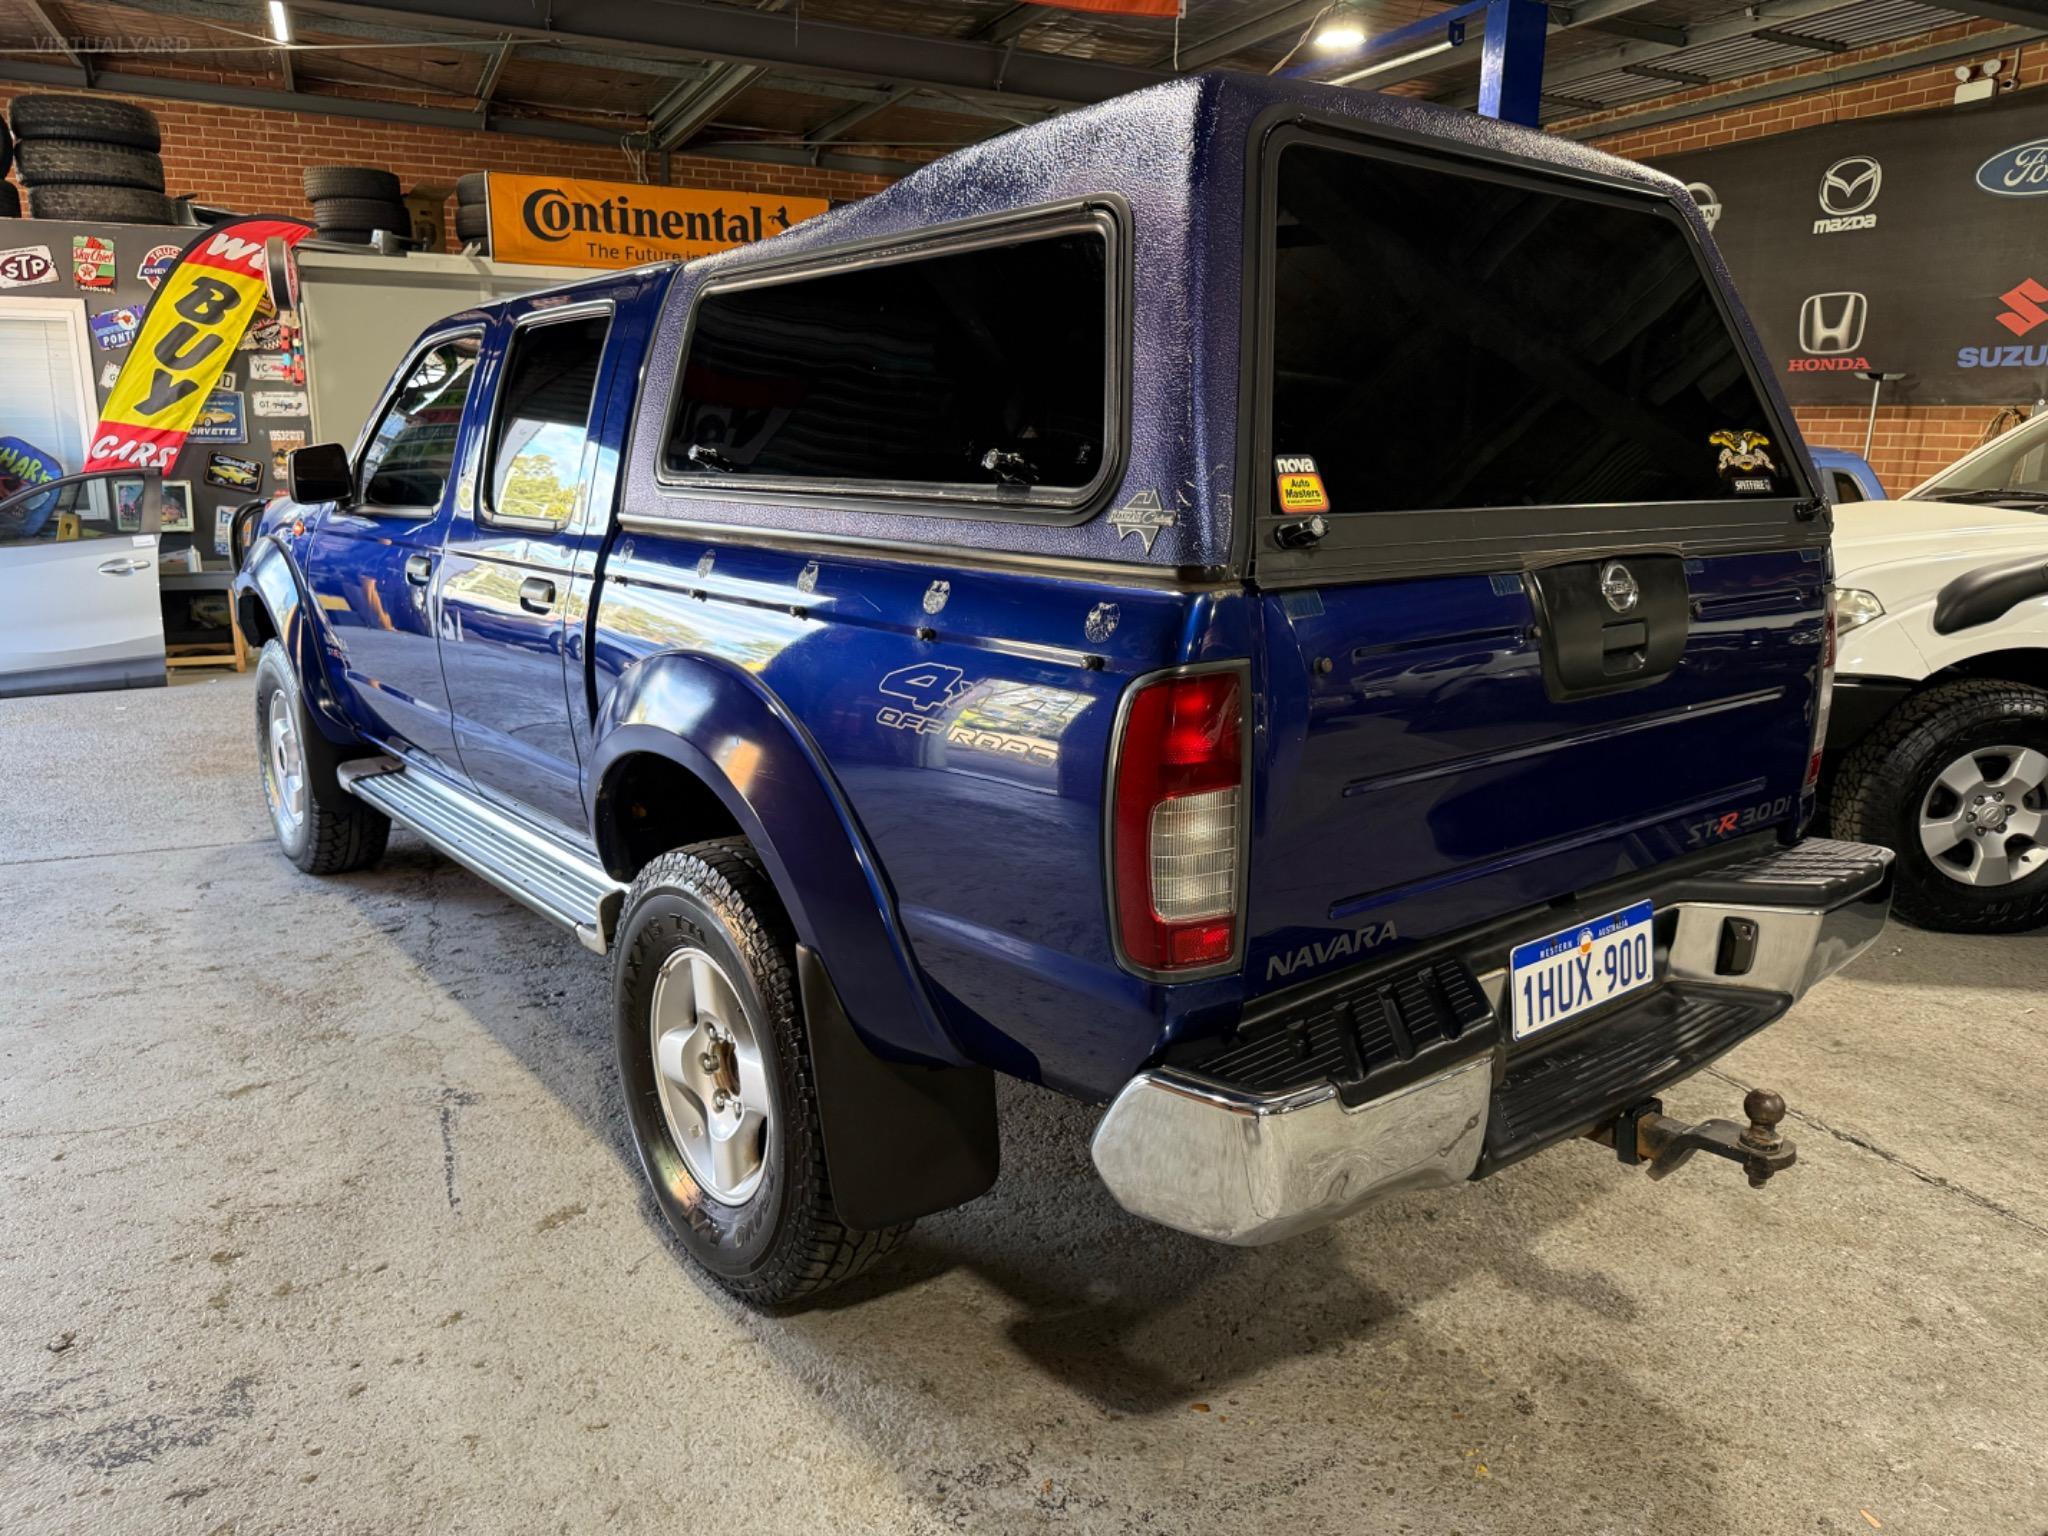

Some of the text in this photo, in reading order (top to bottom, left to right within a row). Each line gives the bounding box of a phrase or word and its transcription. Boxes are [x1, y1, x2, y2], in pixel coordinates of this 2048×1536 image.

[2003, 146, 2048, 187] Fo
[523, 187, 762, 243] Continental
[1813, 213, 1878, 234] mazda
[150, 247, 179, 260] TRUC
[586, 243, 620, 259] The
[626, 245, 682, 261] Future
[5, 256, 45, 279] STP
[103, 331, 135, 346] PONTI
[133, 276, 242, 416] BUY
[1787, 357, 1872, 373] HONDA
[1957, 343, 2048, 369] SUZU
[190, 427, 237, 436] ORVETTE
[91, 435, 177, 467] CARS
[0, 447, 53, 484] HARK
[1276, 458, 1316, 473] nova
[1285, 489, 1320, 498] Masters
[1291, 479, 1310, 488] Auto
[876, 706, 1058, 769] OFF ROAD
[1266, 919, 1399, 981] NAVARA
[1540, 919, 1629, 958] WESTERN AUSTRALIA
